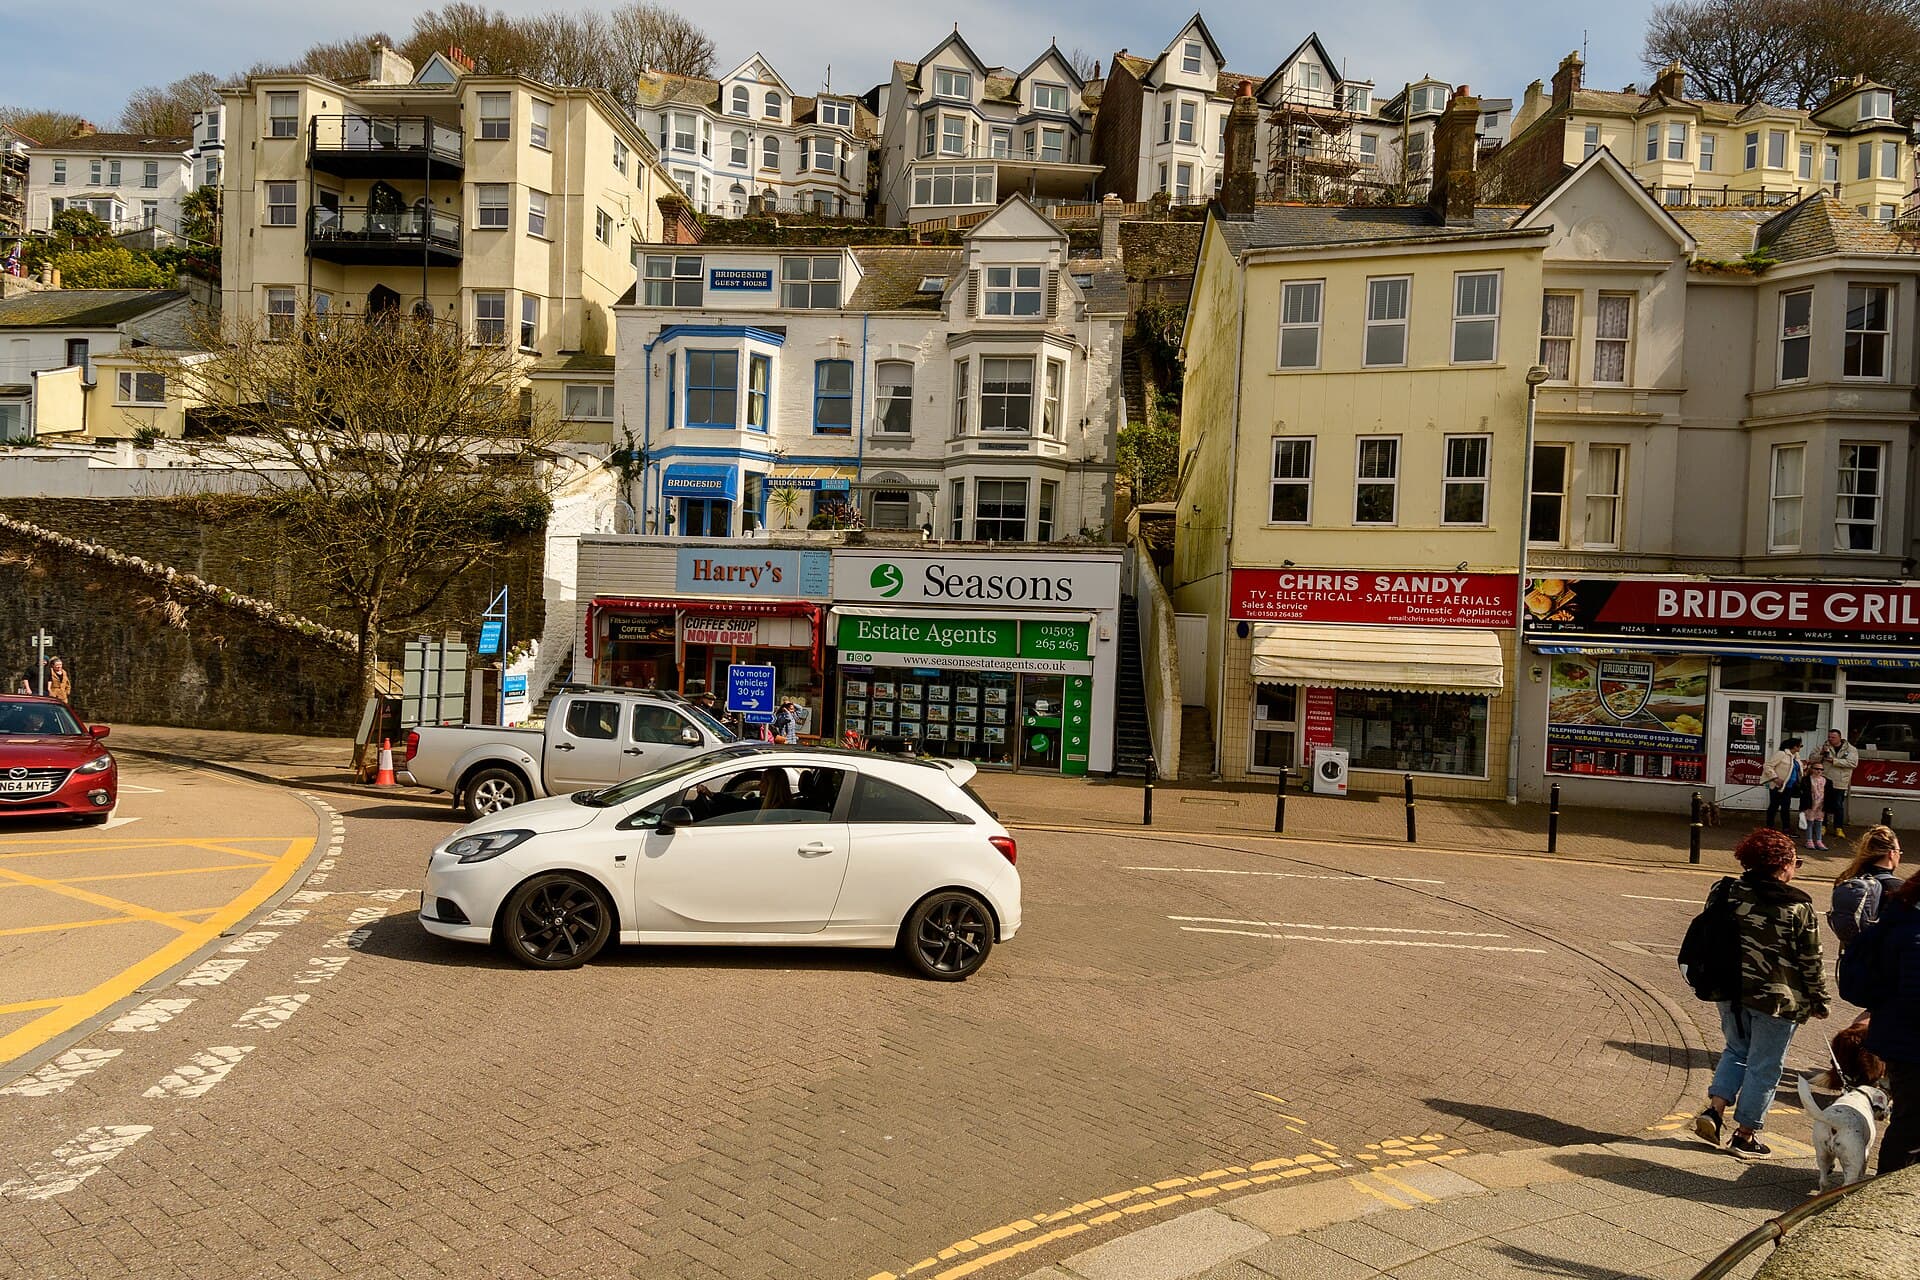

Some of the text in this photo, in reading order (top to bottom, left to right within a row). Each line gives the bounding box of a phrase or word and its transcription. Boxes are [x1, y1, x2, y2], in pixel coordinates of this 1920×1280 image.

[715, 271, 768, 279] BRIDGESIDE
[667, 479, 722, 488] BRIDGESIDE
[768, 479, 816, 487] BRIDGESIDE
[692, 559, 783, 588] Harry's
[923, 564, 1073, 602] Seasons
[1279, 573, 1469, 594] CHRIS SANDY
[1250, 590, 1267, 600] TV
[1276, 591, 1353, 602] ELECTRICAL
[1365, 593, 1433, 604] SATELLITE
[1443, 596, 1501, 606] AERIALS
[1242, 601, 1309, 611] Sales & Service
[1657, 588, 1809, 621] BRIDGE
[1407, 605, 1514, 618] Domestic Appliances
[685, 617, 756, 631] COFFEE SHOP
[687, 630, 753, 644] NOW OPEN
[857, 620, 997, 647] Estate Agents
[1041, 626, 1075, 636] 01503
[1672, 627, 1718, 635] PARMESANS
[1035, 639, 1079, 651] 265 265
[903, 655, 1066, 671] www.seasonsestateagents.co.uk
[1602, 663, 1649, 675] BRIDGE GRILL
[1876, 660, 1904, 668] GRILL
[732, 669, 771, 679] No motor
[735, 679, 769, 688] vehicles
[737, 687, 765, 697] 30 yds
[1549, 727, 1586, 735] TELEPHONE
[1587, 729, 1614, 738] ORDERS
[1615, 733, 1649, 741] WELCOME
[1730, 743, 1761, 751] FOODHUB
[26, 781, 49, 791] MYF
